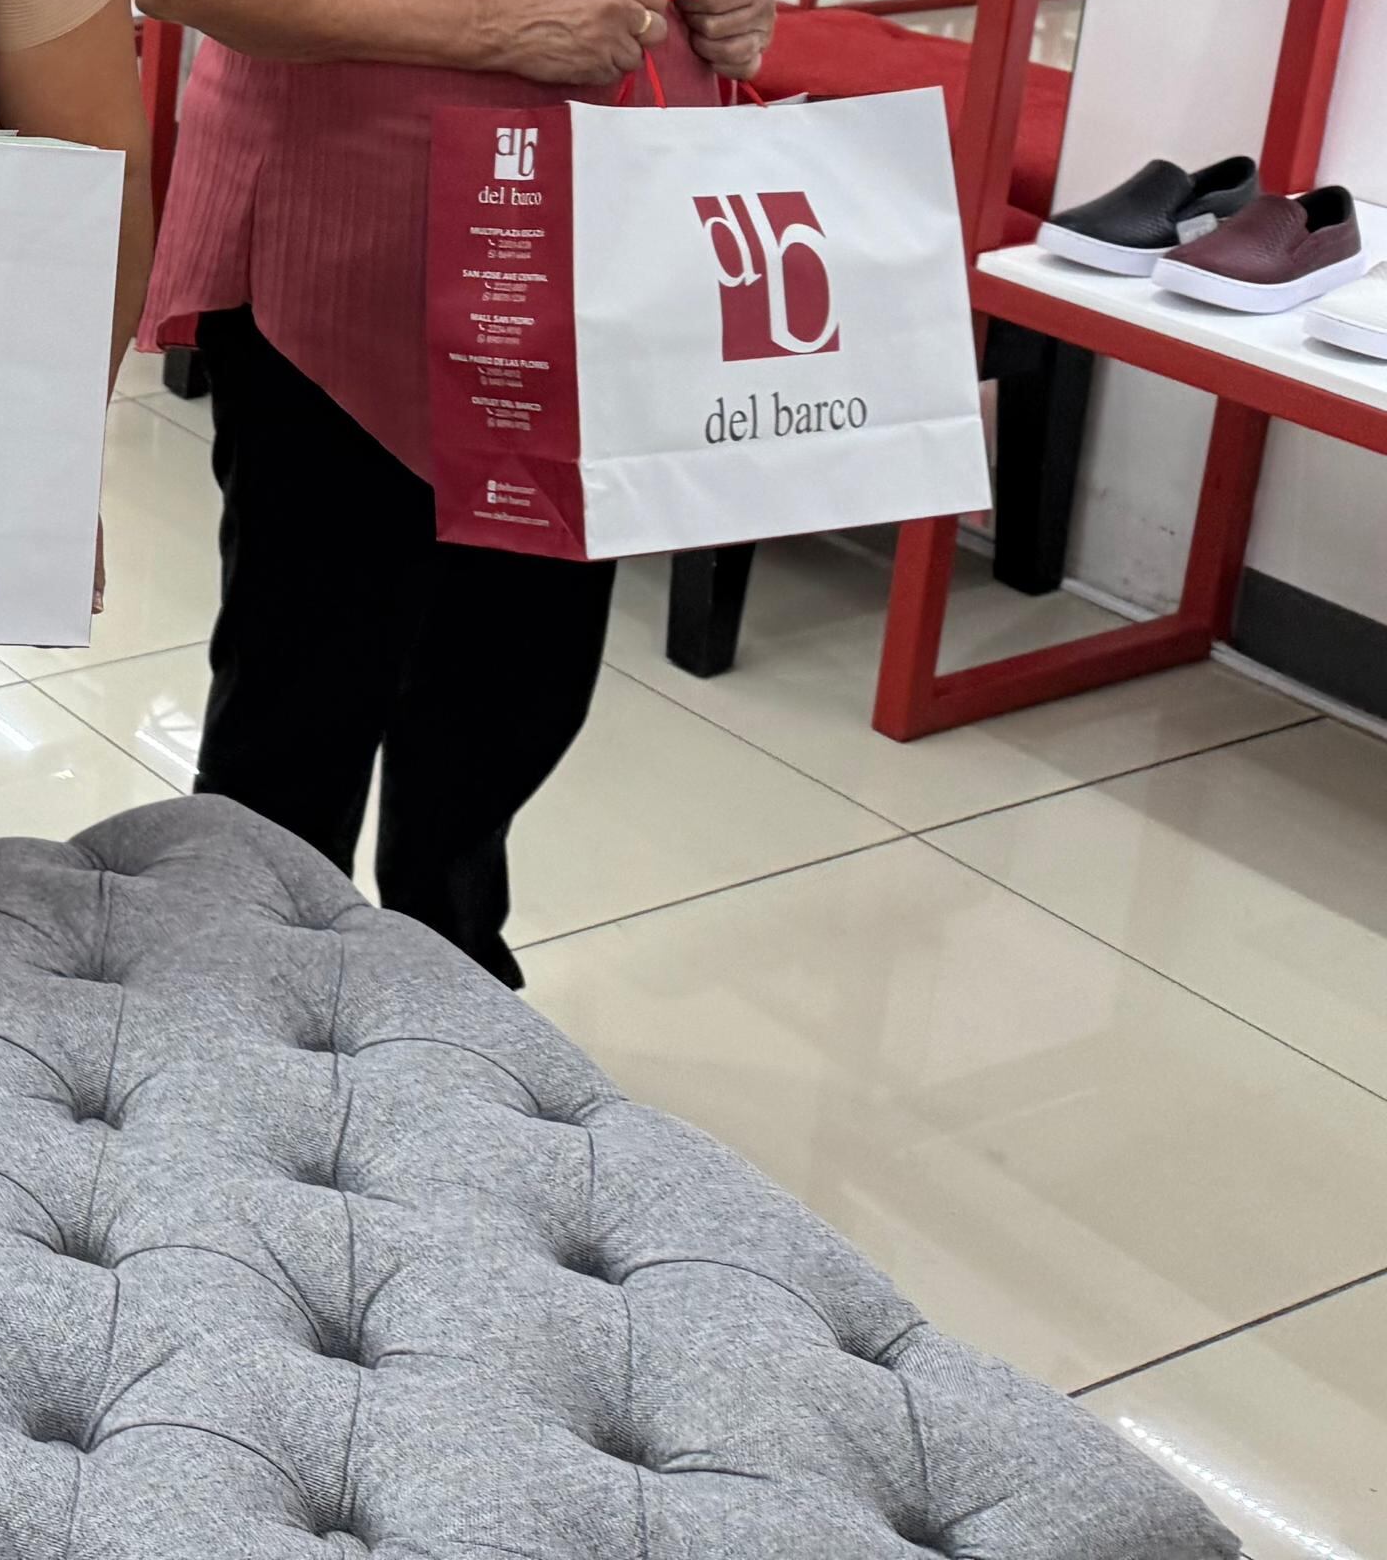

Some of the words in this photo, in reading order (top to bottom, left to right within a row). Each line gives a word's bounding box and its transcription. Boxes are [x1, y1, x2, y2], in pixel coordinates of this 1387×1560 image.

[478, 186, 504, 205] del
[705, 394, 759, 444] del
[771, 392, 868, 437] barco
